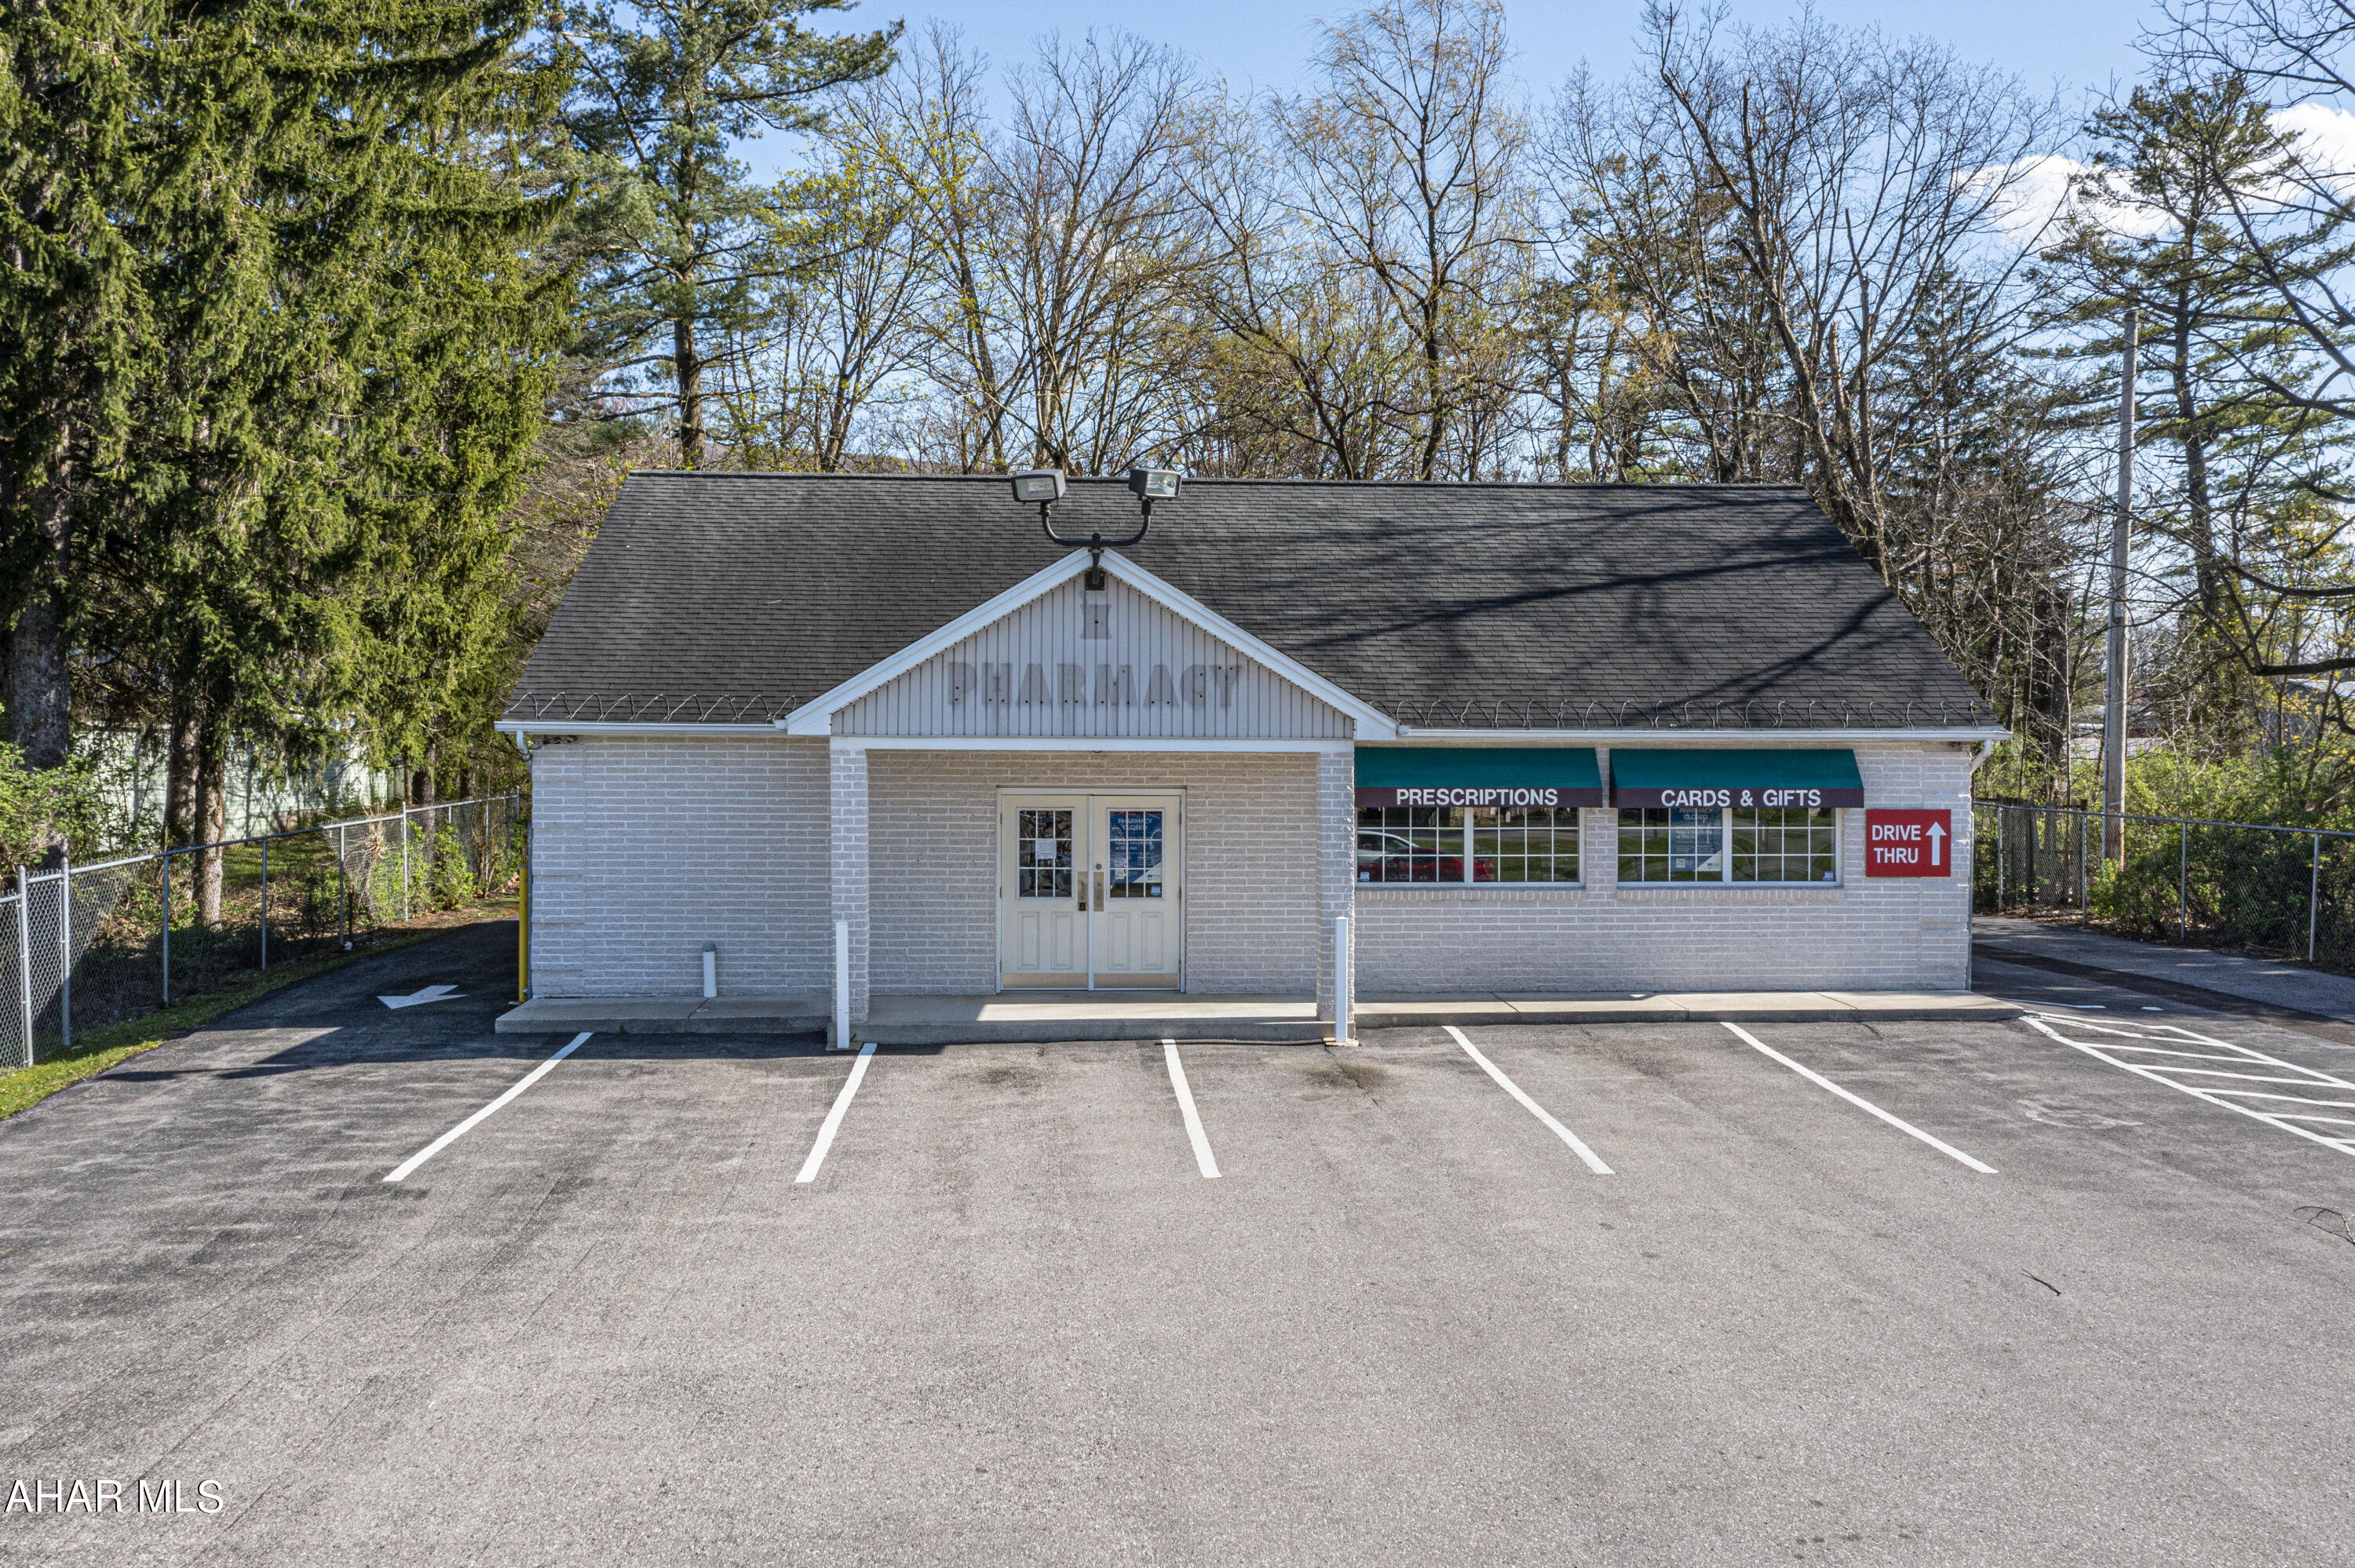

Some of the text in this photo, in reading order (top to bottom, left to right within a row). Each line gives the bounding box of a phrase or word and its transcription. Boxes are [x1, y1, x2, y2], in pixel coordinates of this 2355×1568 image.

[947, 662, 1243, 709] PHARMACY
[1397, 788, 1558, 806] PRESCRIPTIONS
[1661, 789, 1821, 807] CARDS & GIFTS
[1871, 825, 1921, 841] DRIVE
[1874, 848, 1919, 863] THRU
